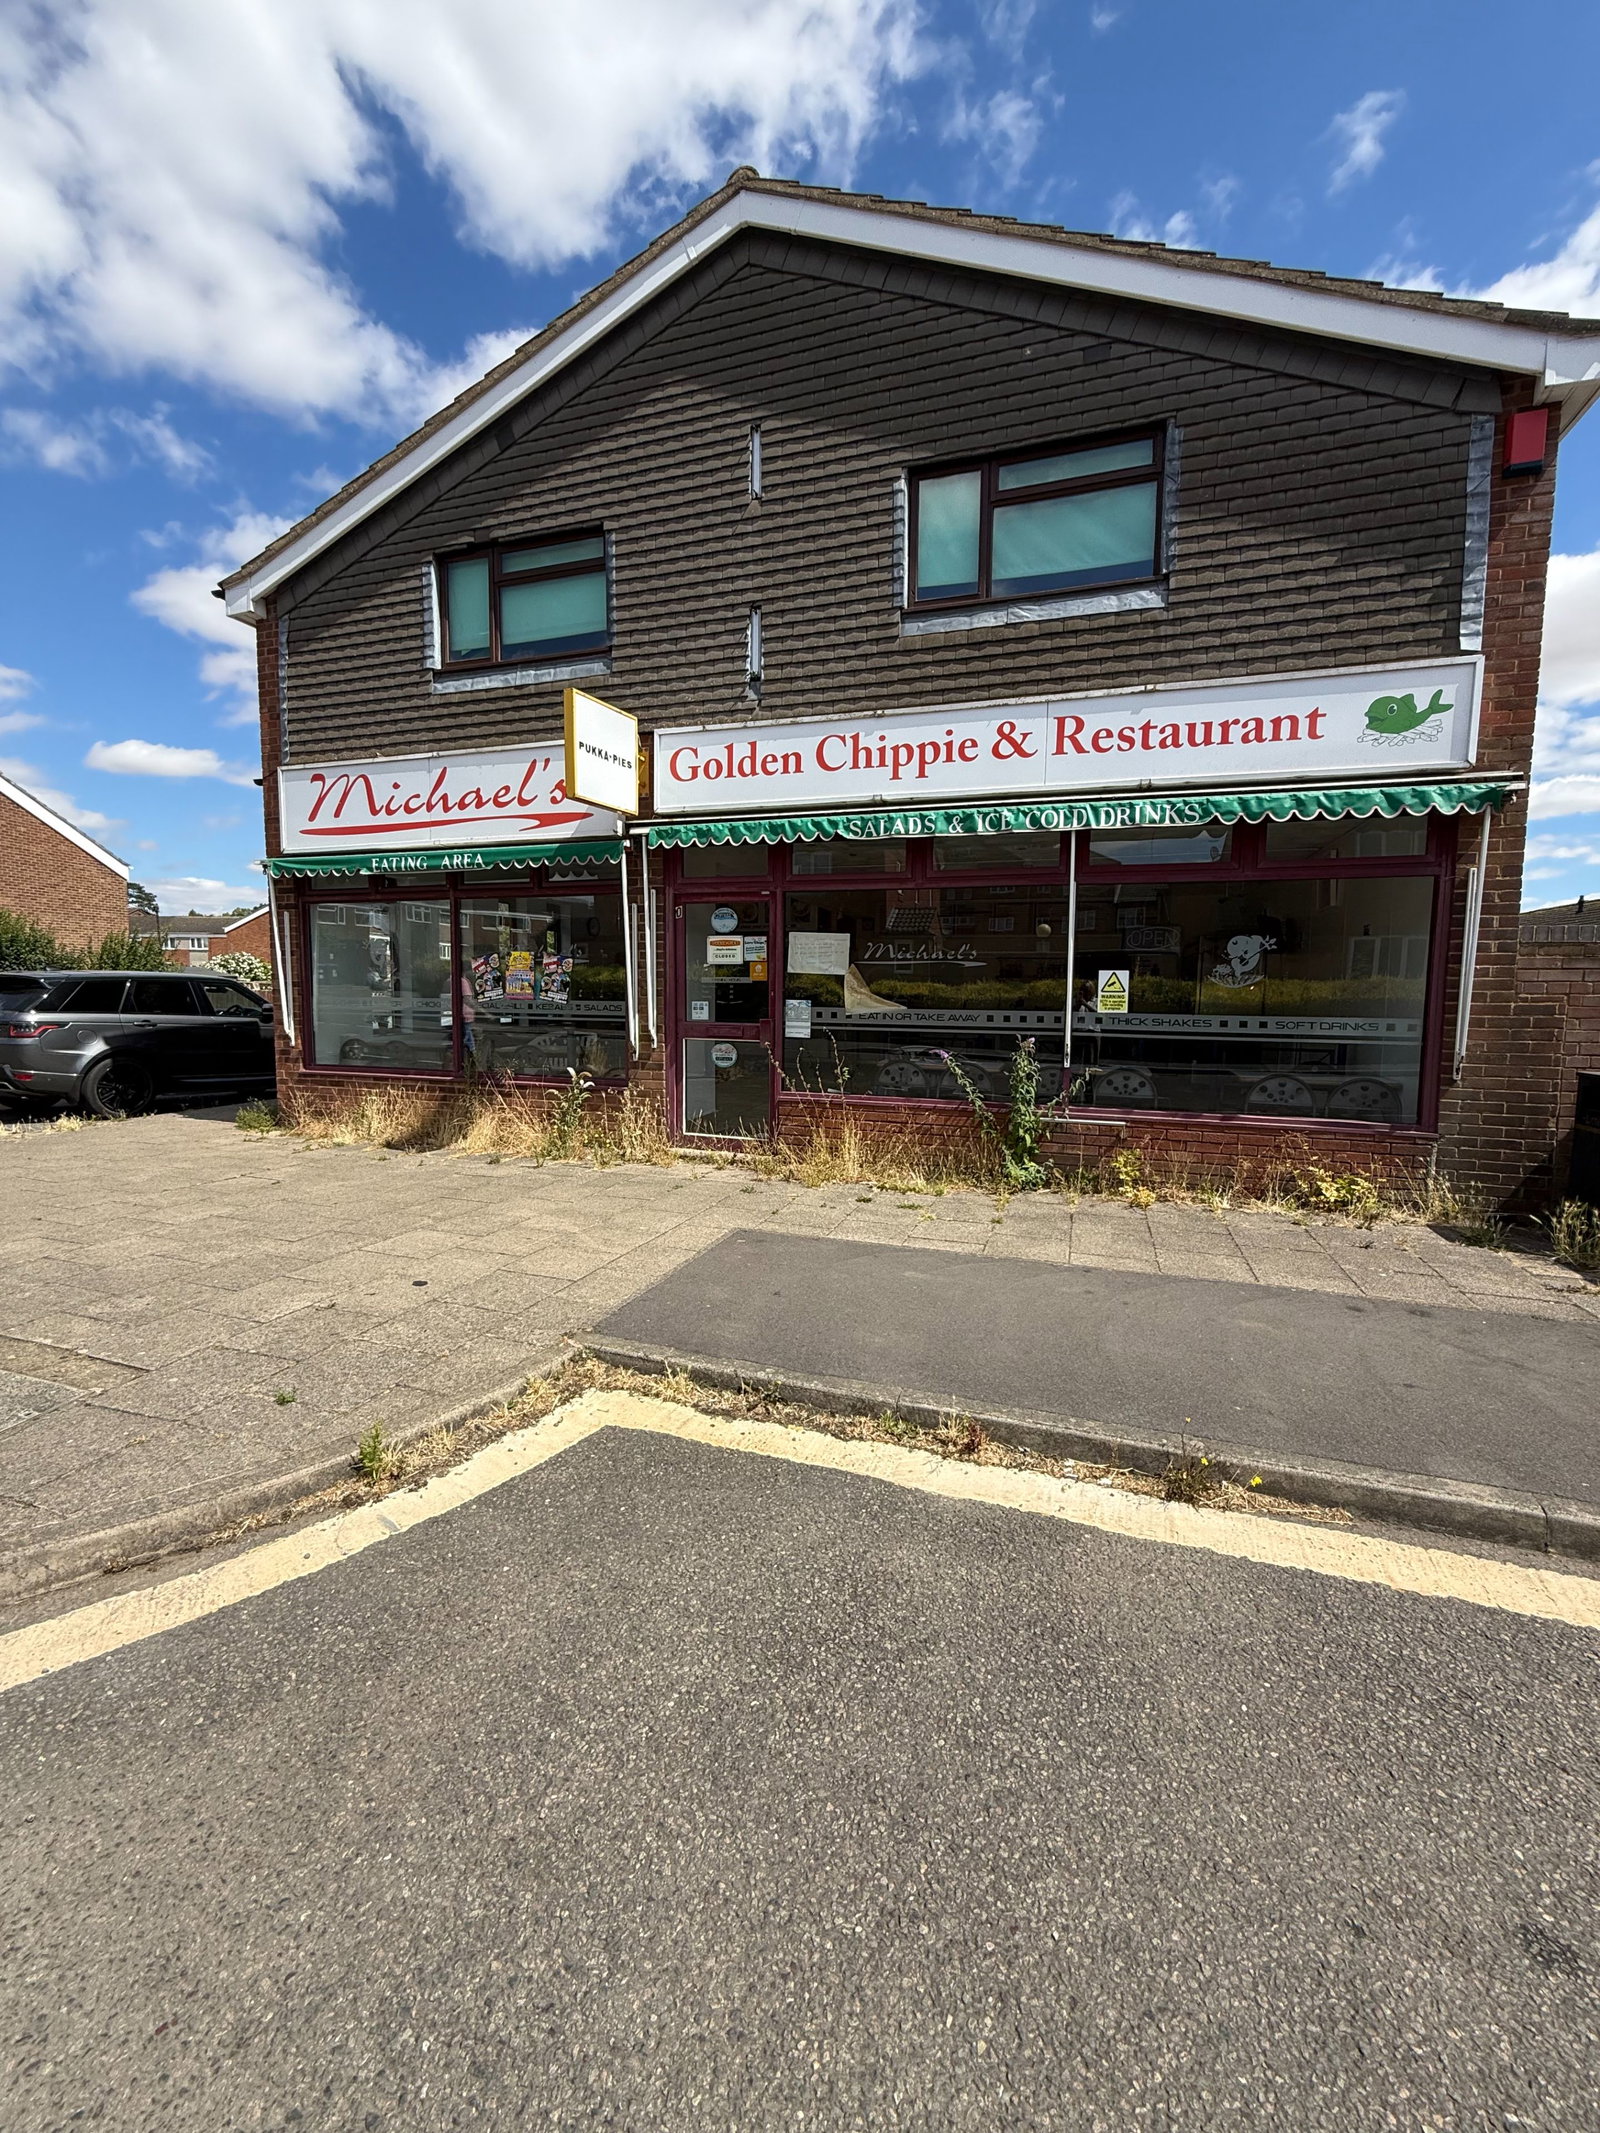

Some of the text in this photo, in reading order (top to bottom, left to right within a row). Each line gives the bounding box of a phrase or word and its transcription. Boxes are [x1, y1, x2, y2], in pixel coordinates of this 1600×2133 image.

[668, 706, 1327, 782] Golden Chippie & Restaurant
[578, 741, 633, 770] PUKKA-PIES
[308, 757, 567, 823] Michael's
[849, 803, 1200, 838] SALADS & ICE COLD DRINKS
[371, 853, 486, 873] EATING AREA
[1130, 930, 1177, 946] OPEN
[864, 942, 977, 960] Michael's
[584, 1004, 623, 1012] SALADS
[858, 1012, 981, 1022] EAT IN OR TAKE AWAY
[1108, 1016, 1212, 1028] THICK SHAKES
[1274, 1020, 1379, 1031] SOFT DRINKS
